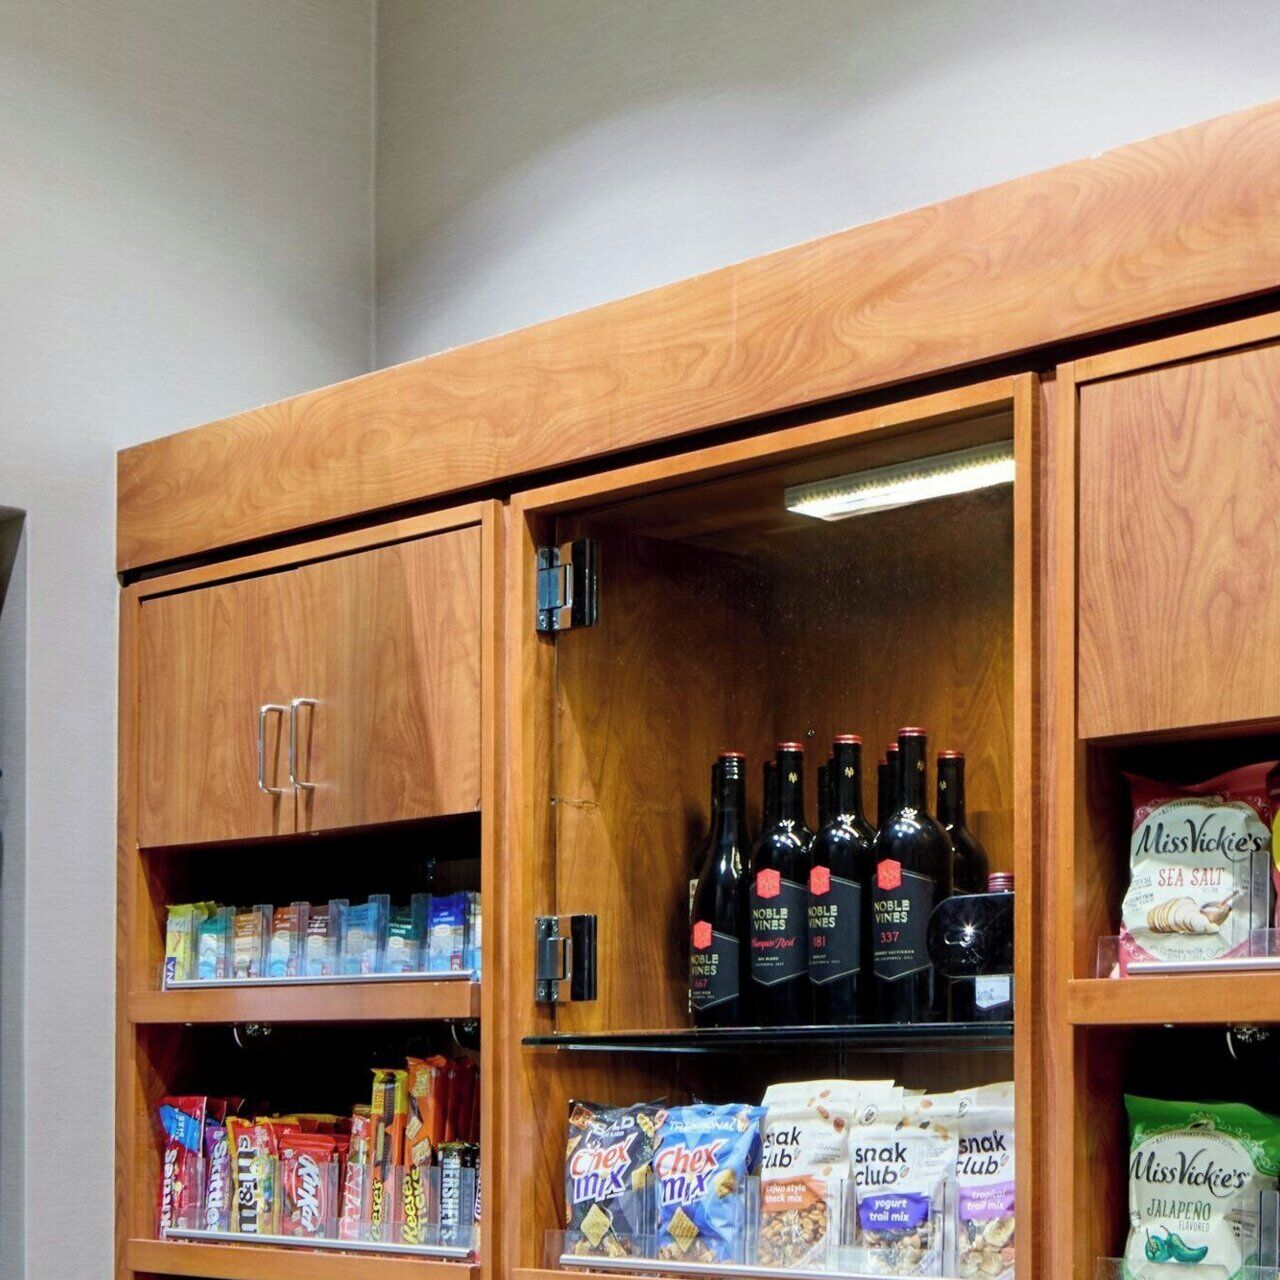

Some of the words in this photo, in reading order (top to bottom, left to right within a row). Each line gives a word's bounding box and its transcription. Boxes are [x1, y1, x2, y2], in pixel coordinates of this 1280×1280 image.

[1136, 822, 1191, 858] Miss
[1185, 814, 1262, 861] Vickie's
[1159, 869, 1187, 887] SEA
[1192, 867, 1225, 886] SALT
[808, 904, 839, 917] NOBLE
[874, 899, 911, 913] NOBLE
[753, 908, 789, 920] NOBLE
[876, 911, 909, 924] VINES
[754, 919, 786, 931] VINES
[809, 917, 837, 929] VINES
[813, 936, 827, 948] 181
[880, 931, 901, 944] 337
[690, 953, 719, 965] NOBLE
[691, 965, 717, 977] VINES
[960, 1130, 1008, 1154] snak
[571, 1134, 638, 1177] Chex
[655, 1140, 727, 1178] Chex
[856, 1142, 909, 1164] snak
[855, 1163, 899, 1187] club
[1131, 1150, 1182, 1188] Miss
[1176, 1148, 1248, 1197] Vickie's
[573, 1166, 627, 1204] mix
[661, 1167, 714, 1205] mix
[765, 1183, 787, 1196] cajun
[787, 1183, 807, 1194] style
[787, 1194, 803, 1204] mix
[874, 1199, 908, 1213] yogurt
[967, 1202, 989, 1214] trail
[990, 1201, 1006, 1212] mix
[1146, 1198, 1212, 1222] JALAPEÑO
[869, 1210, 891, 1223] trail
[892, 1211, 910, 1223] mix
[1178, 1220, 1211, 1233] FLAVORED
